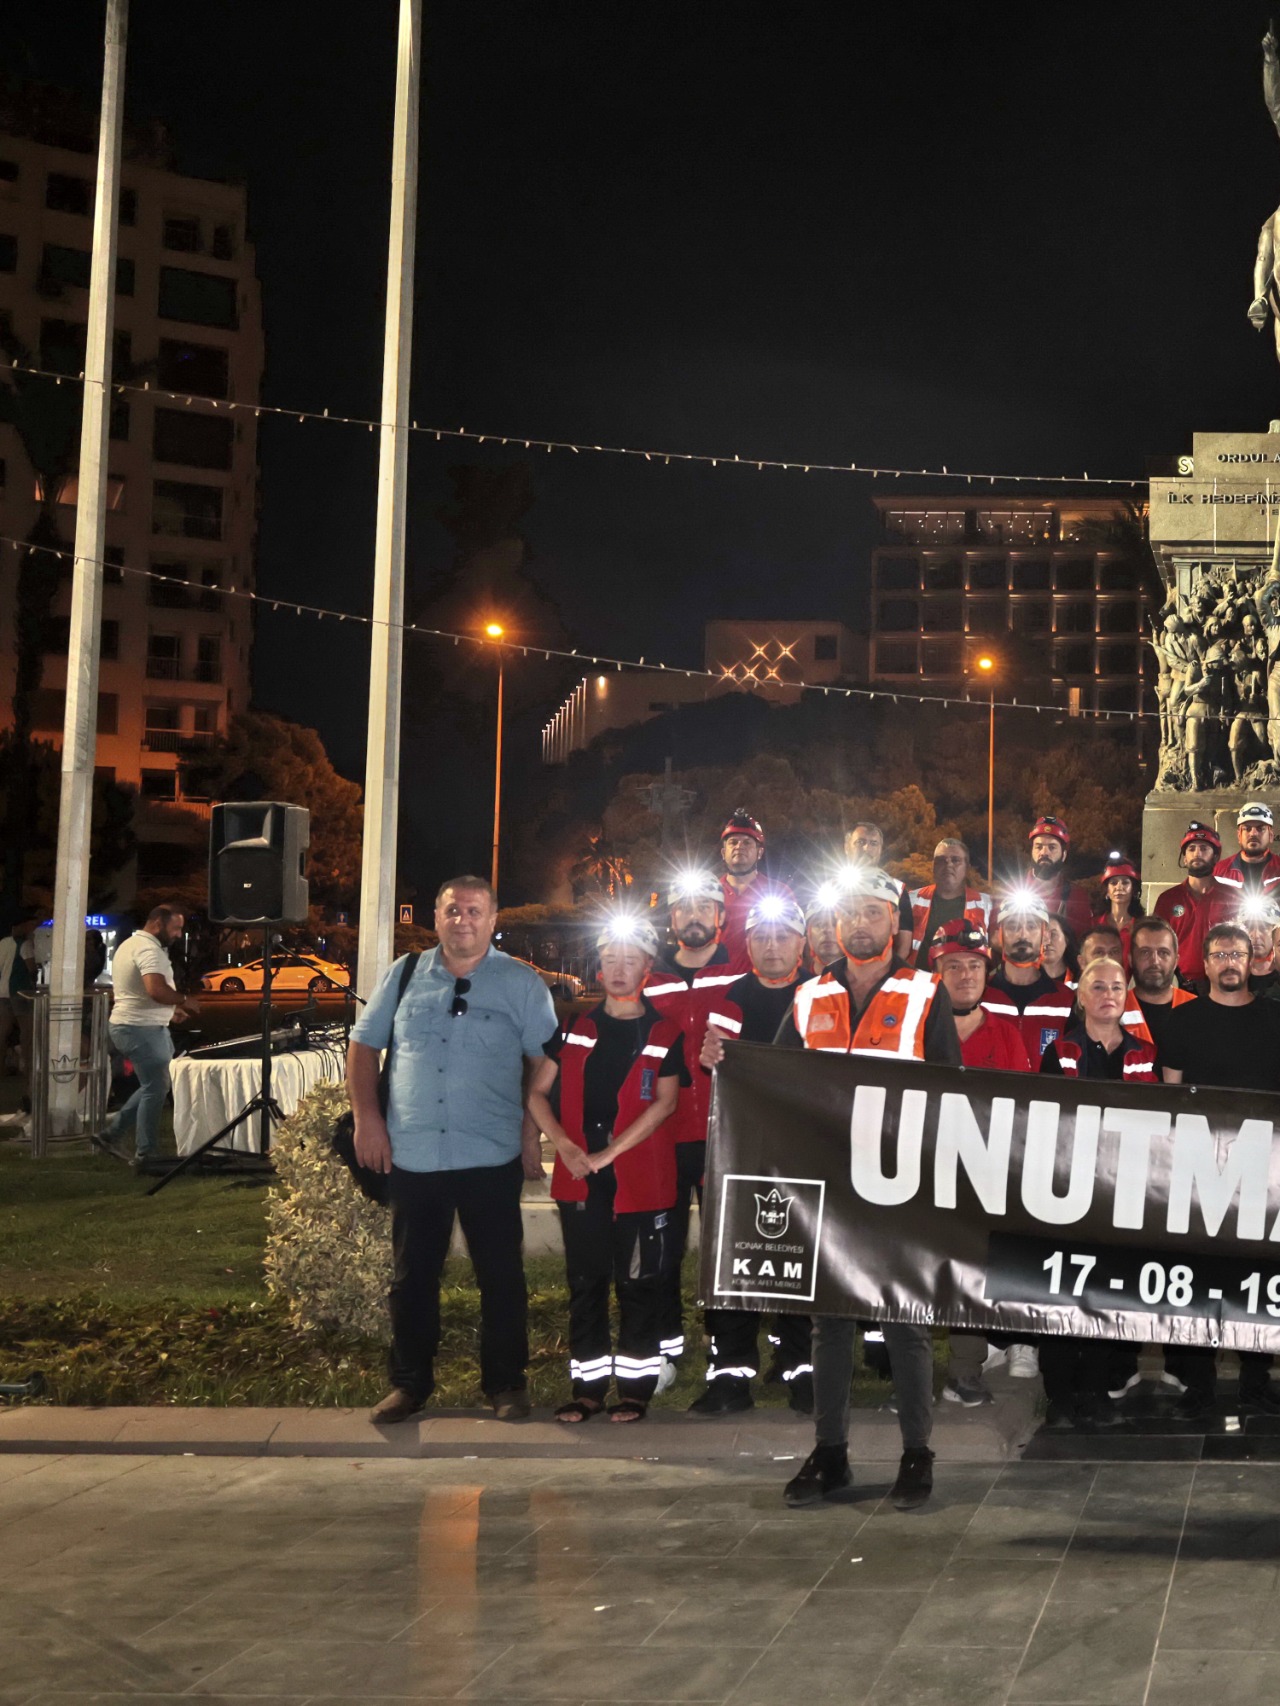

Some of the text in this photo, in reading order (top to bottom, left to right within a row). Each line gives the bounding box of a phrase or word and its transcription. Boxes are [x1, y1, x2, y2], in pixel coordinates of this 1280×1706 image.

[734, 1241, 763, 1250] KONAK
[732, 1258, 803, 1279] KAM
[1043, 1251, 1097, 1296] 17
[1139, 1262, 1194, 1307] 08
